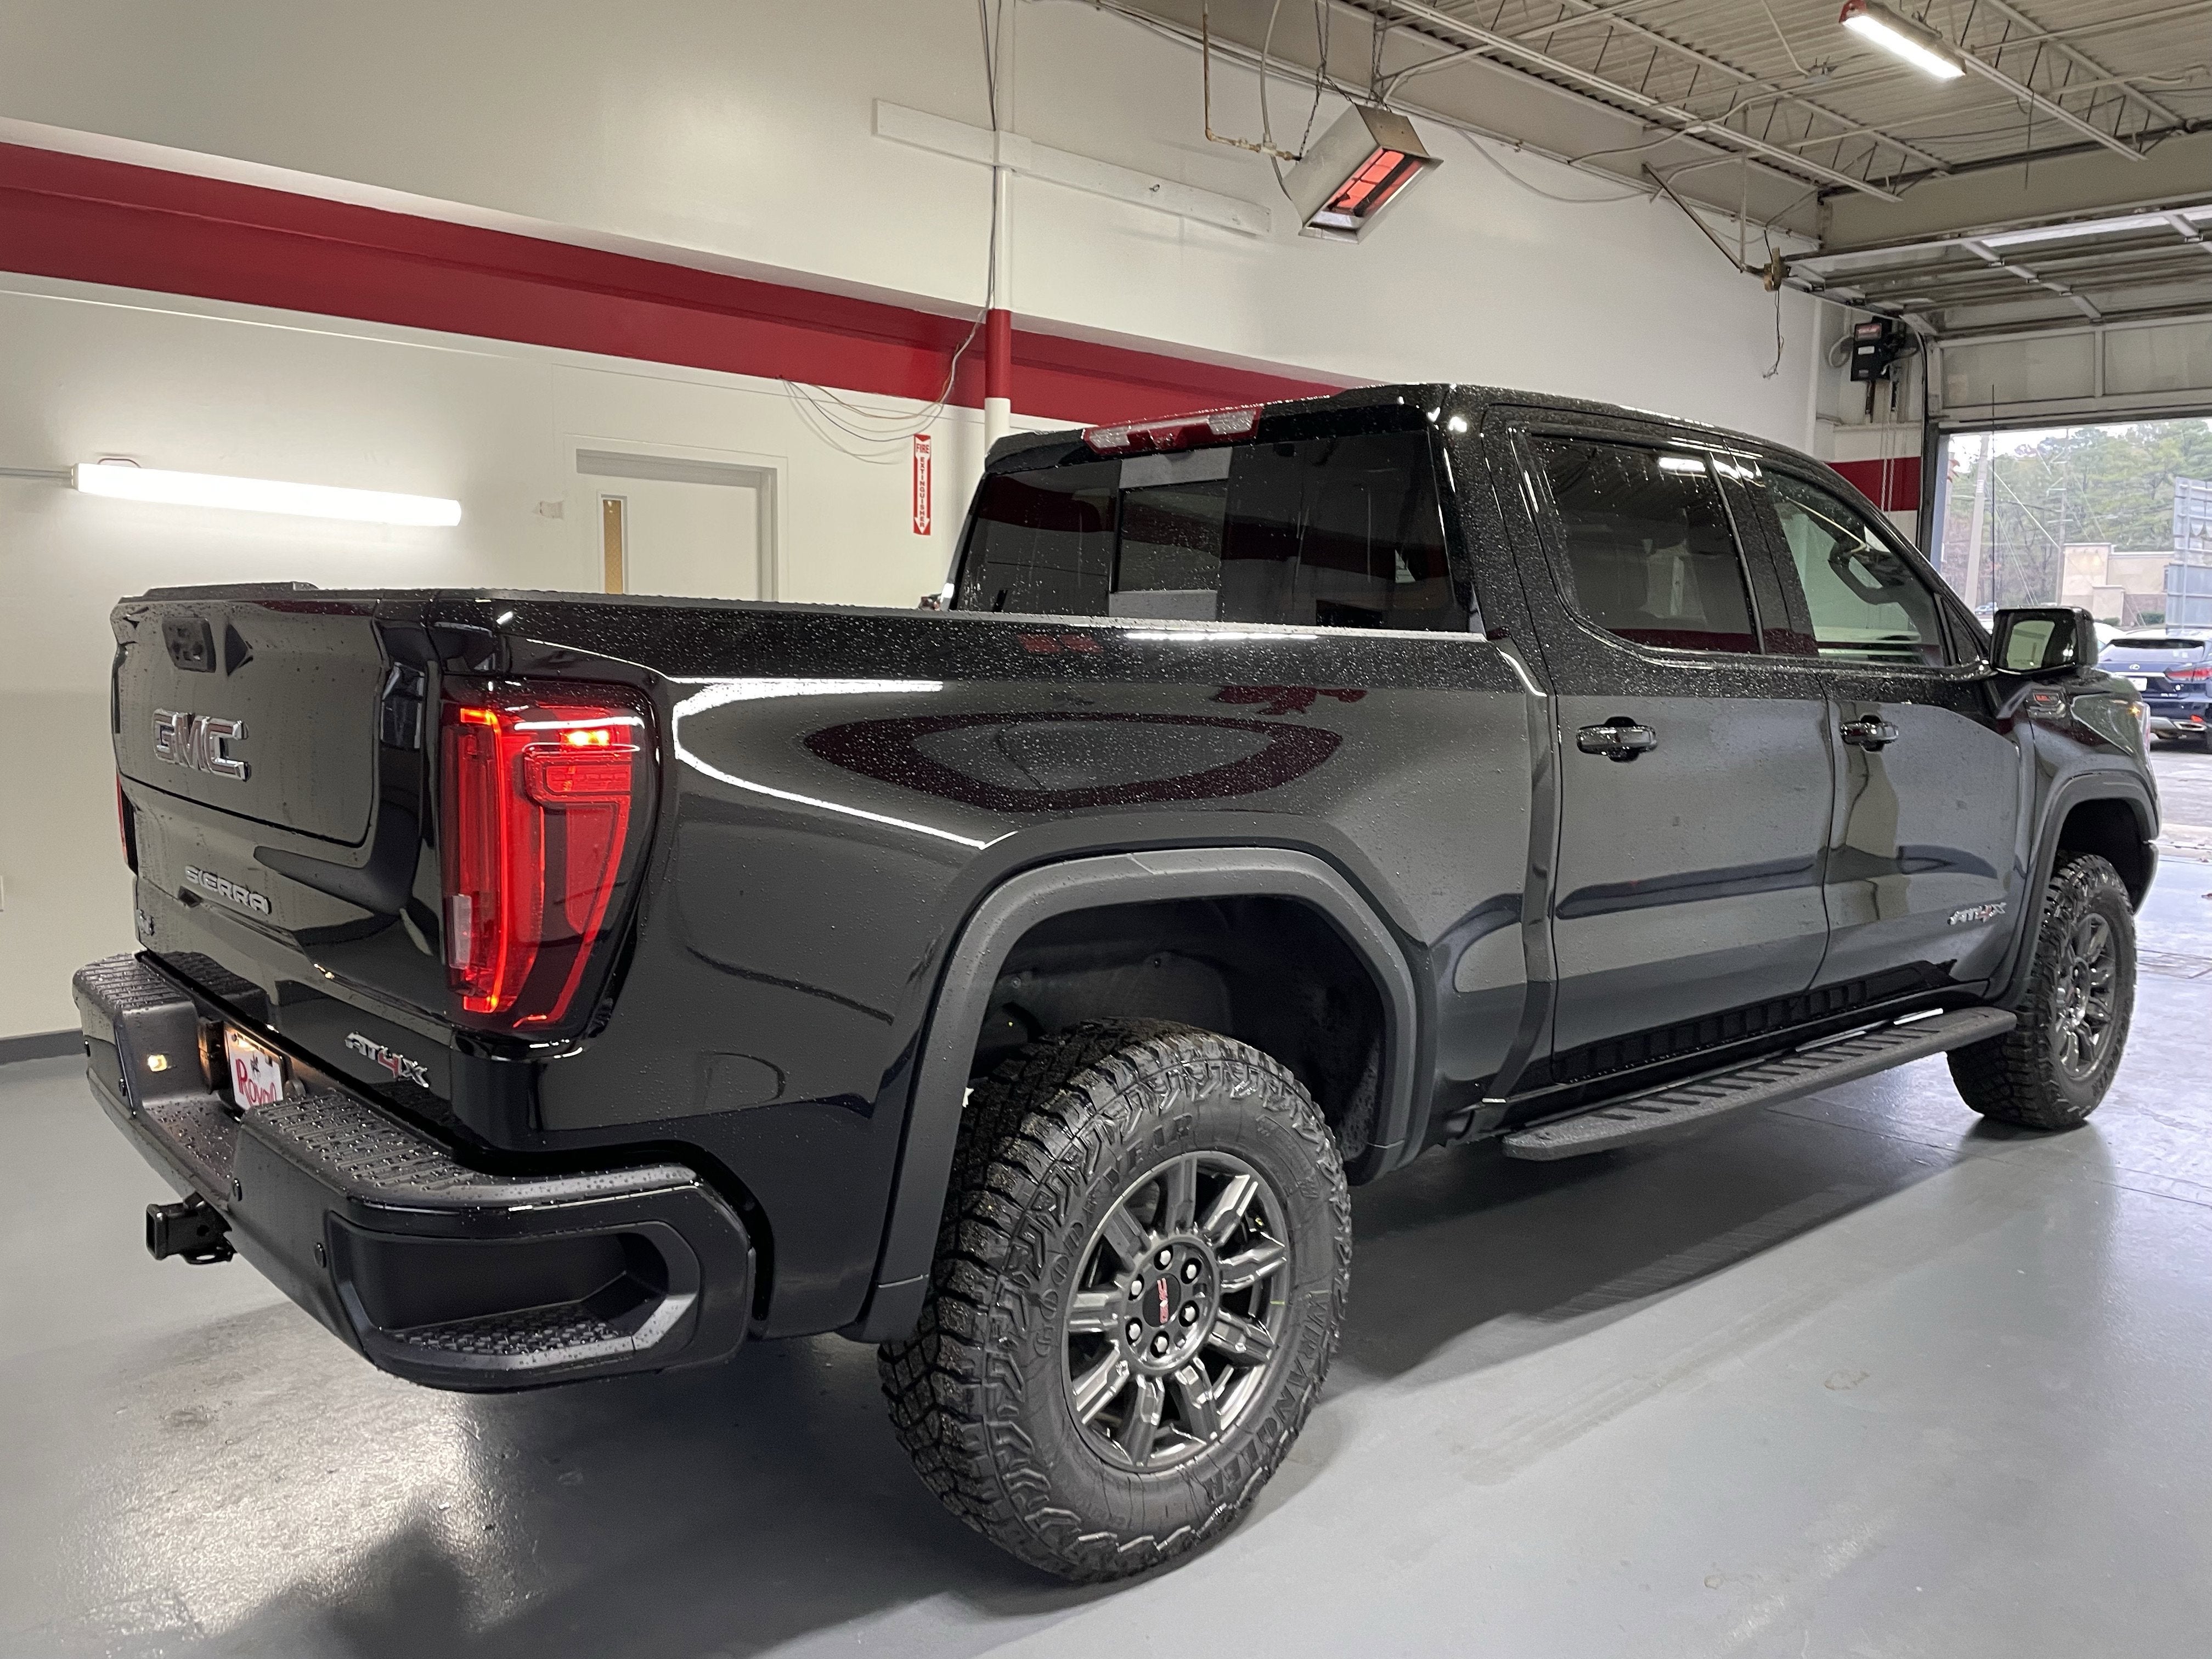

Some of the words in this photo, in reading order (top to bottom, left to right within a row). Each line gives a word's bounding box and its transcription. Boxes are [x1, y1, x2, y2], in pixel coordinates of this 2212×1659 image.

[916, 443, 929, 453] FIRE
[152, 708, 251, 782] GMC
[185, 865, 271, 915] SIERRA
[345, 1031, 429, 1088] AT4X
